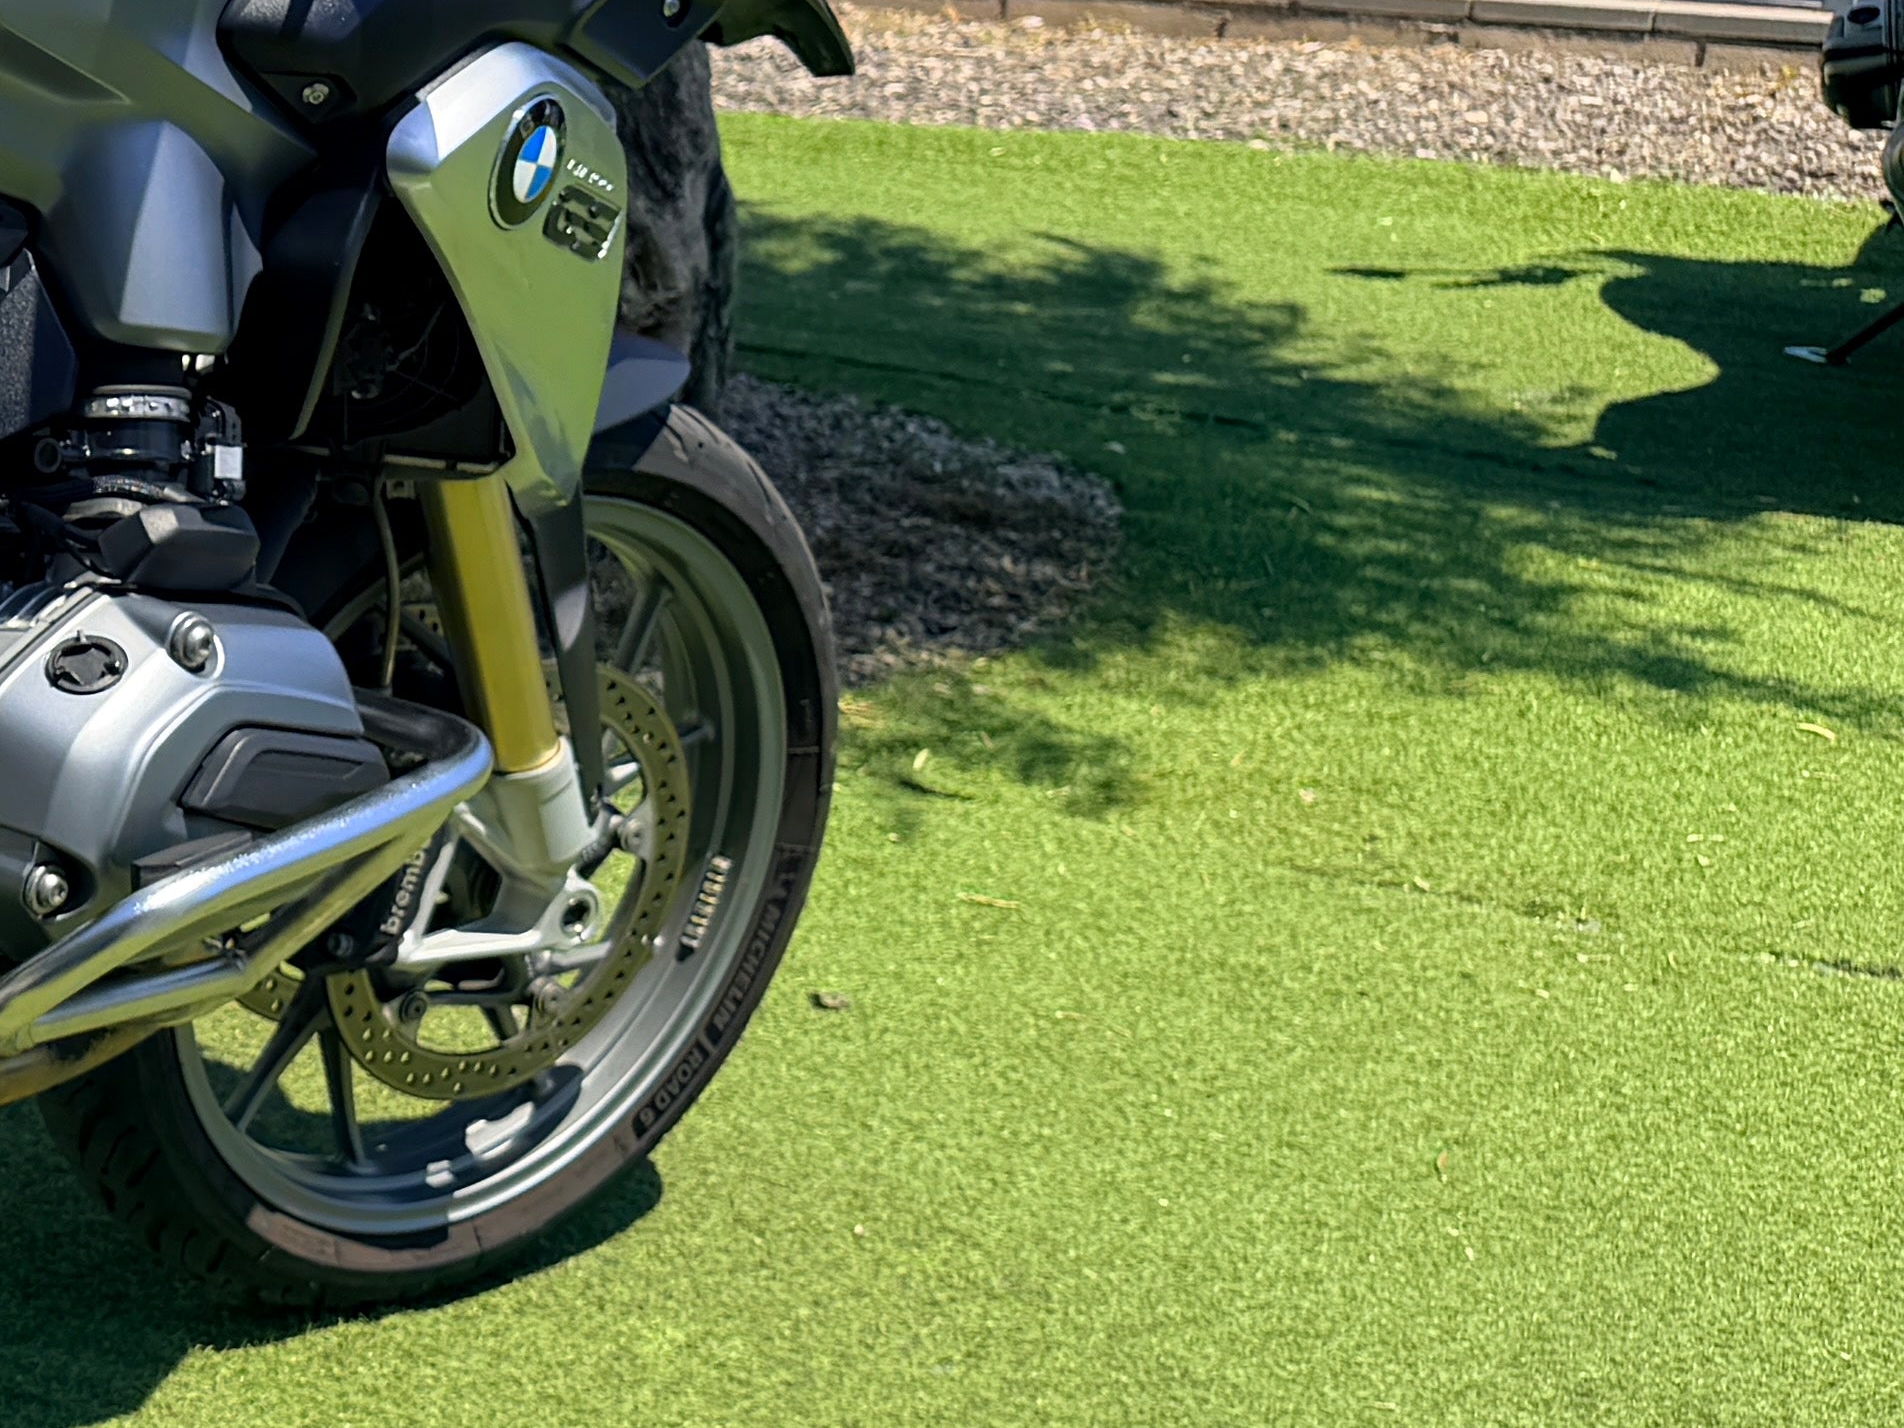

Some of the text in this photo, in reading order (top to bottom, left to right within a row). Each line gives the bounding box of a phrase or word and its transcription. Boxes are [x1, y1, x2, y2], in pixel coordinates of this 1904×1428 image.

[379, 848, 426, 935] bremb
[709, 900, 783, 1032] MICHELIN
[653, 1036, 710, 1113] ROAD
